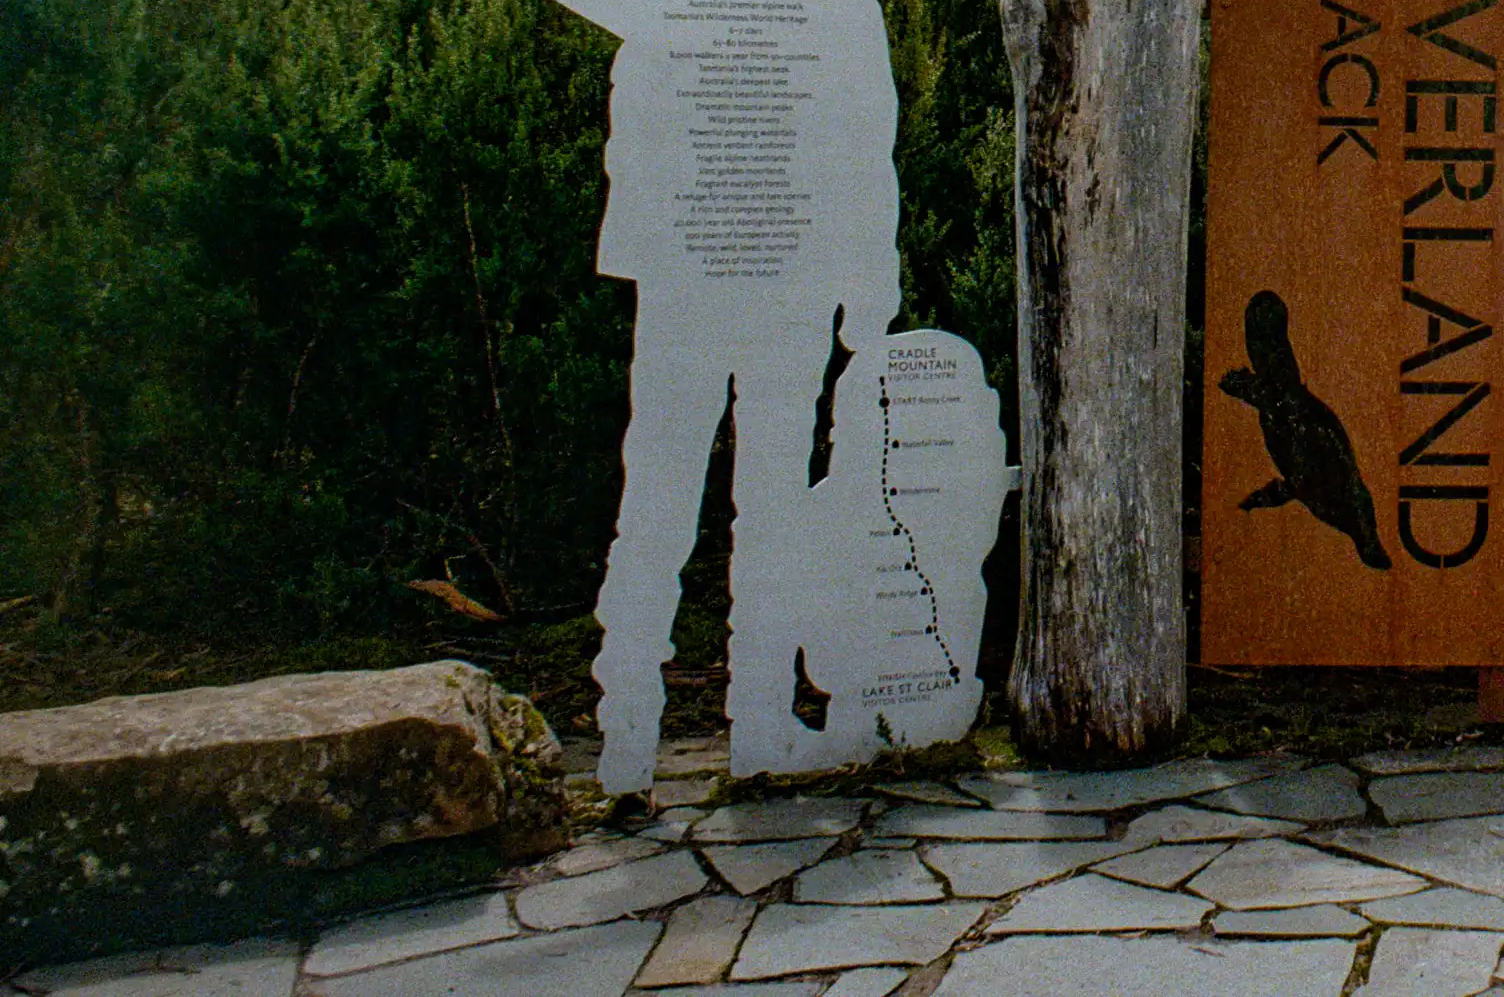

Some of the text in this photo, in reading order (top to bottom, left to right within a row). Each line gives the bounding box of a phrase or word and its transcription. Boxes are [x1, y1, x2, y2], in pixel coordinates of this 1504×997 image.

[706, 14, 748, 22] Wilderness
[750, 15, 773, 23] World
[888, 347, 936, 360] CRADLE
[888, 359, 957, 372] MOUNTAIN
[888, 372, 957, 382] VISITOR CENTRE
[862, 679, 952, 698] LAKE ST CLAIR
